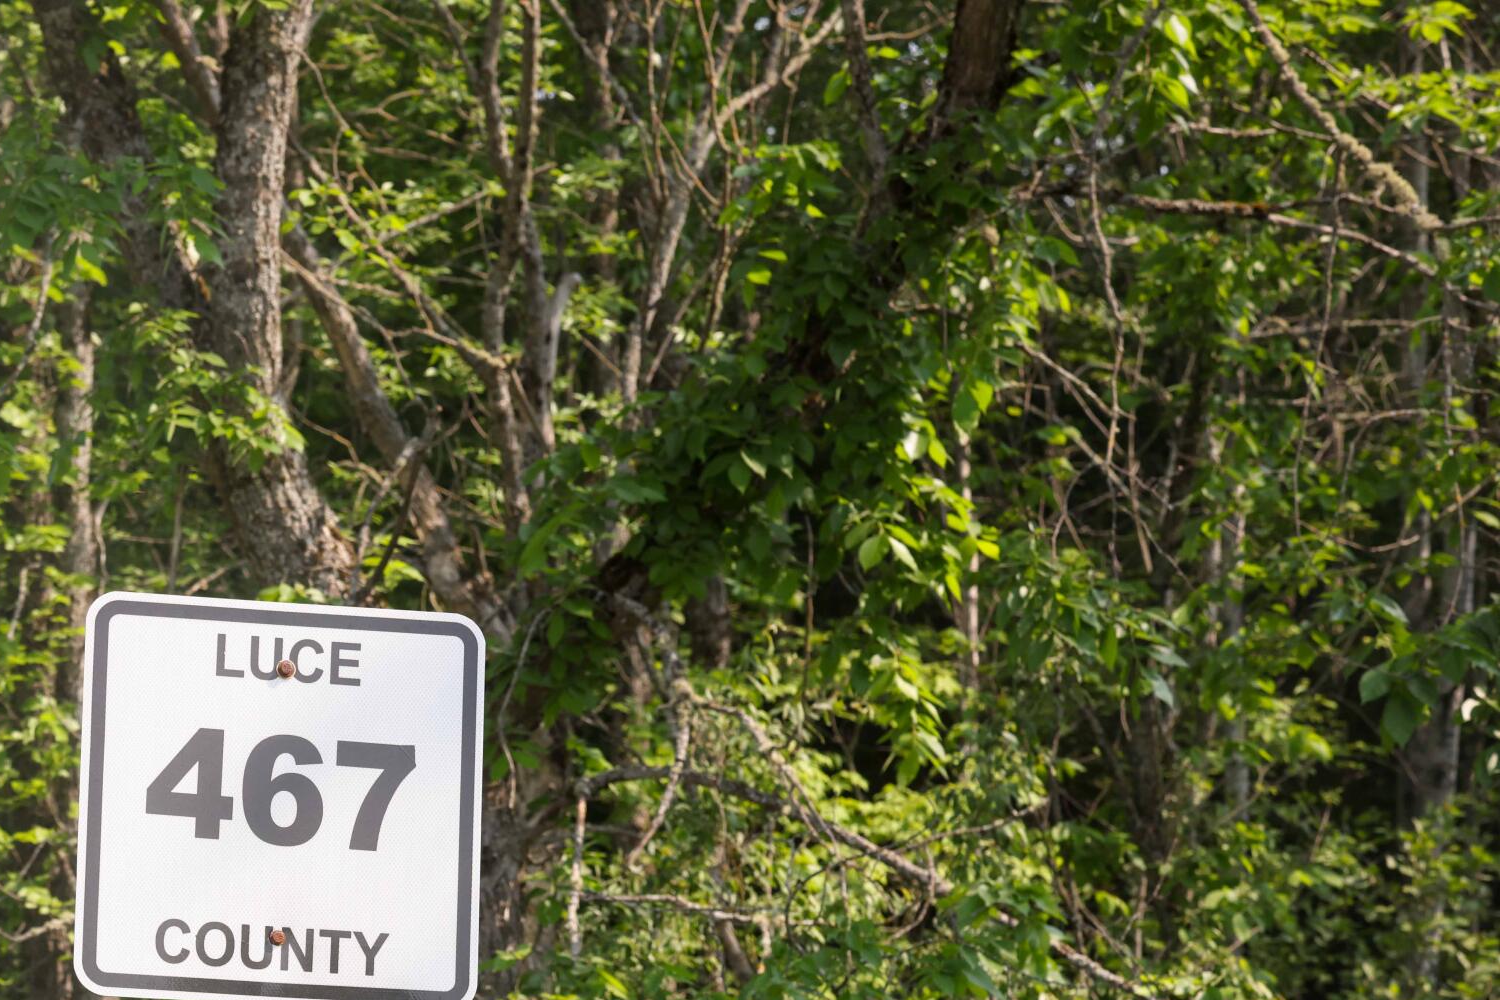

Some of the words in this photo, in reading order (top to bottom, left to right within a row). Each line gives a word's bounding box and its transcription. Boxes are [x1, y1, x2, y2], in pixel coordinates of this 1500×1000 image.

[216, 633, 362, 686] LUCE
[145, 727, 417, 852] 467
[155, 918, 390, 976] COUNTY
